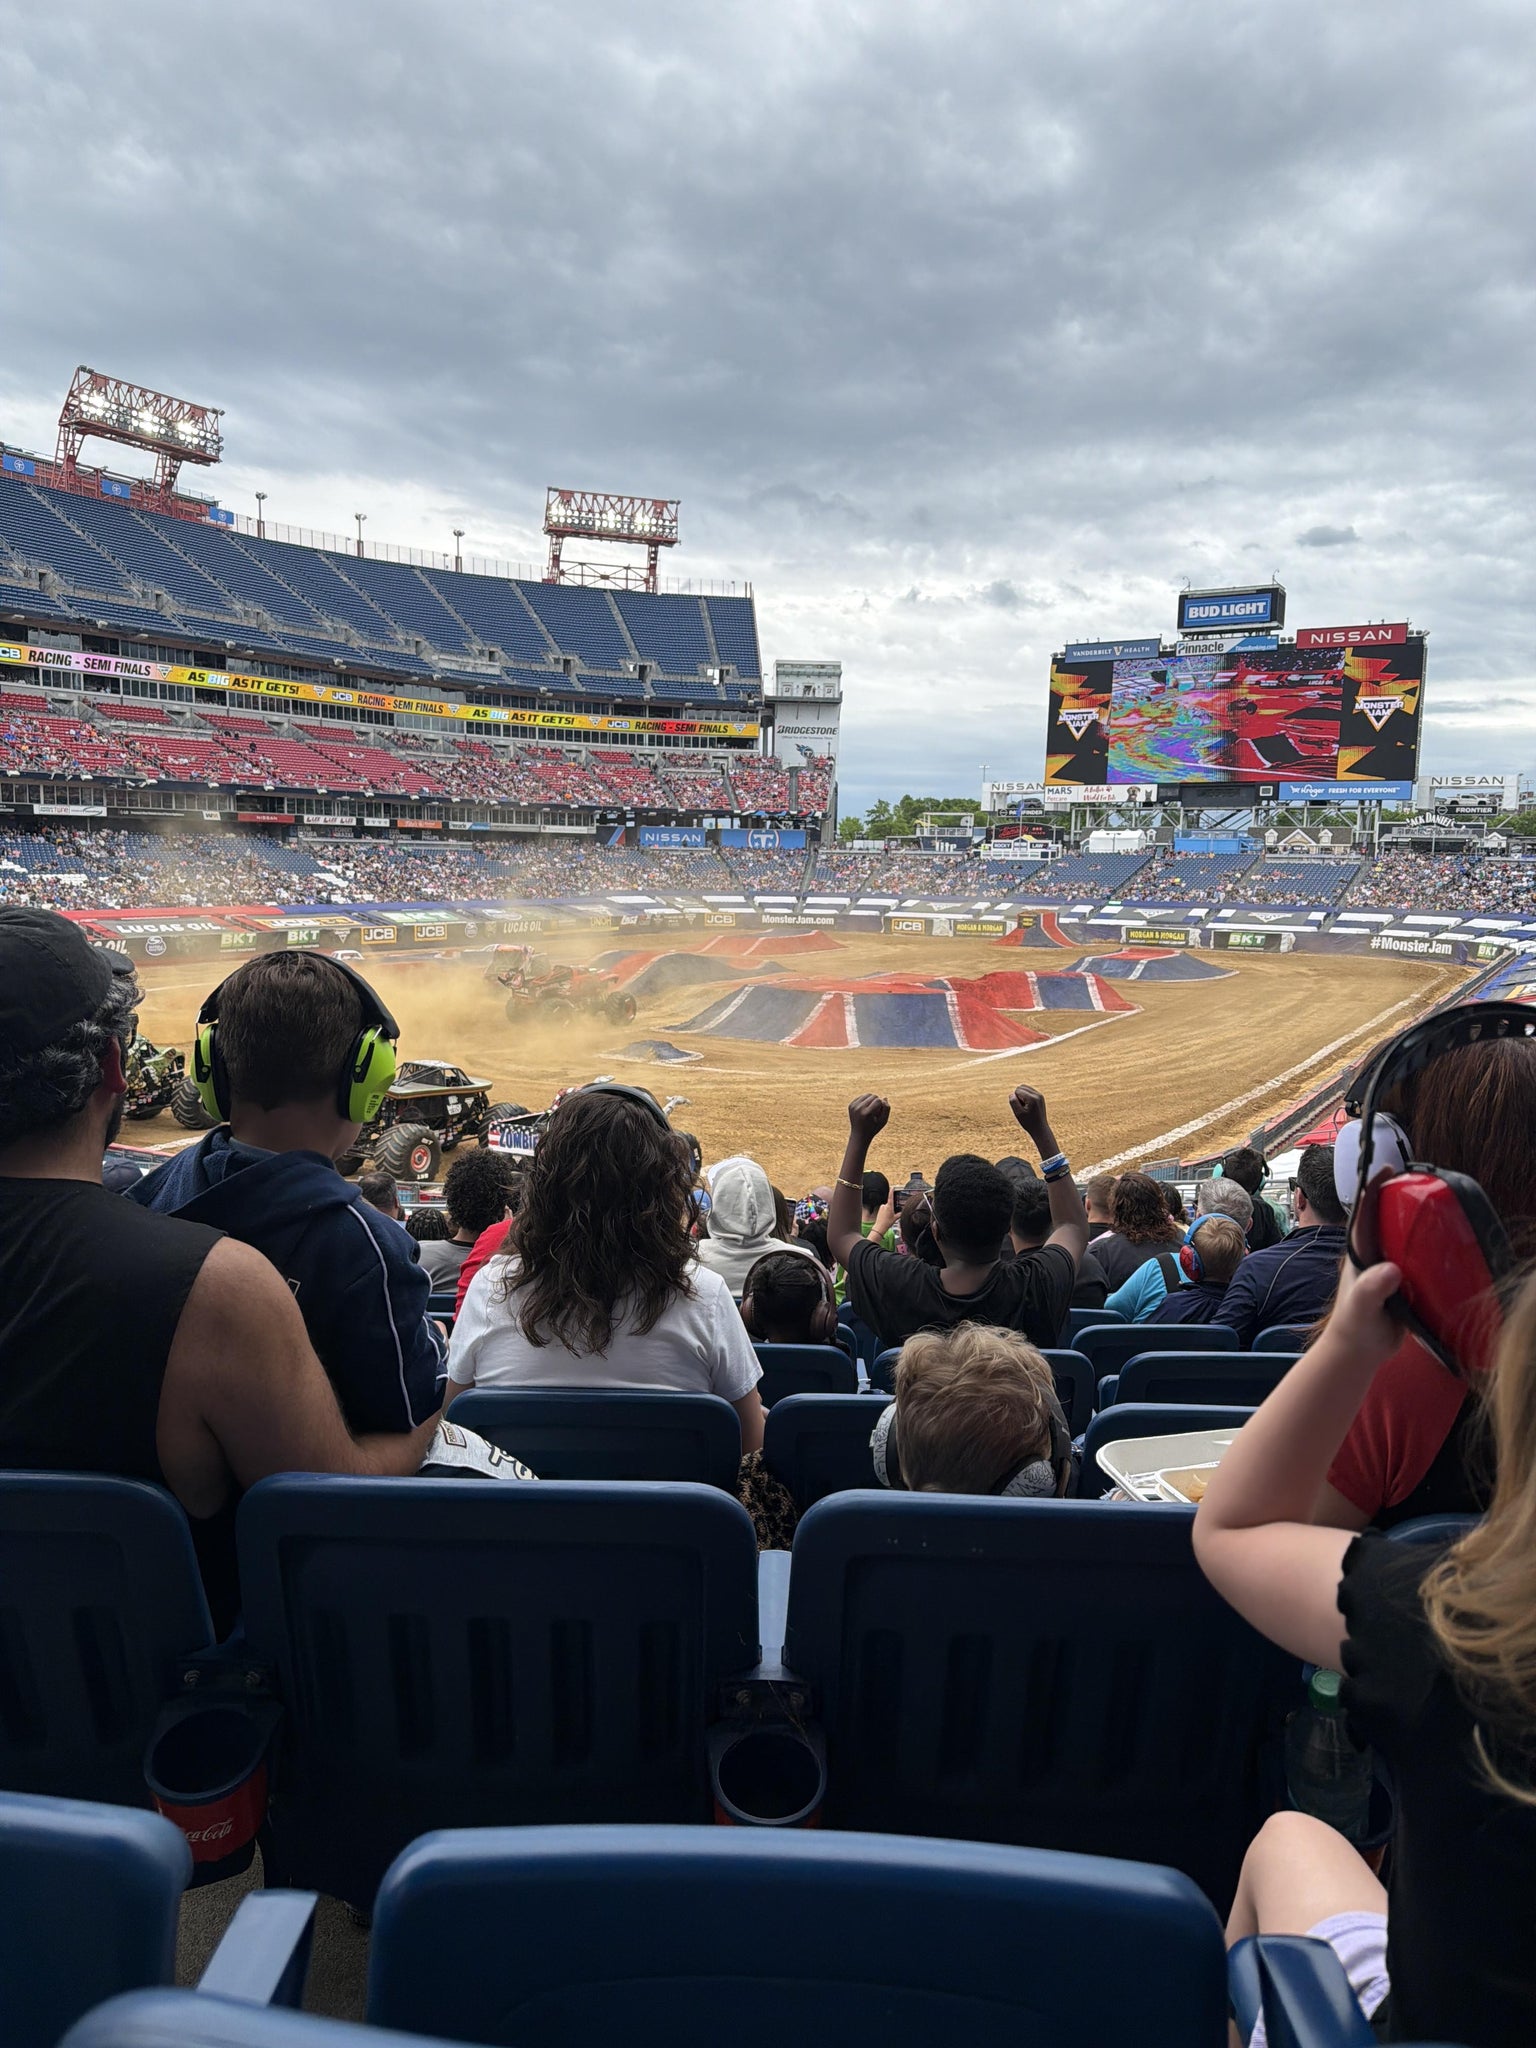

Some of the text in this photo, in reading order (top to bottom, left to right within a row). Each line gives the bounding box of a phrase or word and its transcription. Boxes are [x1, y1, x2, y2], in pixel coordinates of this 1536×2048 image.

[1188, 602, 1267, 618] BUD LIGHT
[1310, 629, 1392, 644] NISSAN
[1177, 641, 1225, 655] Pinnacle
[0, 647, 21, 659] CB
[28, 649, 72, 666] RACING
[84, 657, 111, 671] SEMI
[114, 661, 151, 676] FINALS
[187, 671, 300, 695] AS BIG AS IT GETS!
[331, 691, 353, 702] JCB
[357, 694, 386, 707] RACING
[393, 699, 413, 711] SEMI
[415, 702, 444, 714] FINALS
[1355, 701, 1404, 709] MONSTER
[472, 709, 488, 718] AS
[511, 712, 526, 722] AS
[527, 714, 540, 723] IT
[541, 715, 575, 726] GETS!
[1369, 708, 1391, 716] JAM
[607, 719, 630, 729] JCB
[634, 720, 667, 732] RACING
[674, 723, 697, 733] SEMI
[698, 723, 729, 734] FINALS
[777, 725, 838, 736] BRIDGESTONE
[991, 783, 1045, 791] NISSAN
[1431, 776, 1504, 785] NISSAN
[1047, 787, 1073, 795] MARS
[1300, 784, 1325, 798] Kroger
[1406, 815, 1426, 828] JACK
[645, 833, 701, 843] NISSAN
[707, 914, 733, 924] JCB
[762, 914, 835, 925] MonsterJam.com
[116, 921, 223, 934] LUCAS OIL
[417, 925, 445, 938] JCB
[503, 920, 542, 934] LUCAS OIL
[894, 921, 922, 932] JCB
[956, 923, 977, 931] MORGAN
[982, 924, 1004, 932] MORGAN
[221, 932, 257, 945] BKT
[287, 929, 320, 942] BKT
[364, 928, 394, 940] JCB
[1129, 930, 1186, 940] MORGAN & MORGAN
[1229, 933, 1265, 944] BKT
[1370, 936, 1452, 955] #MonsterJam
[1478, 944, 1498, 956] BKT
[186, 1816, 234, 1842] ca-Cola
